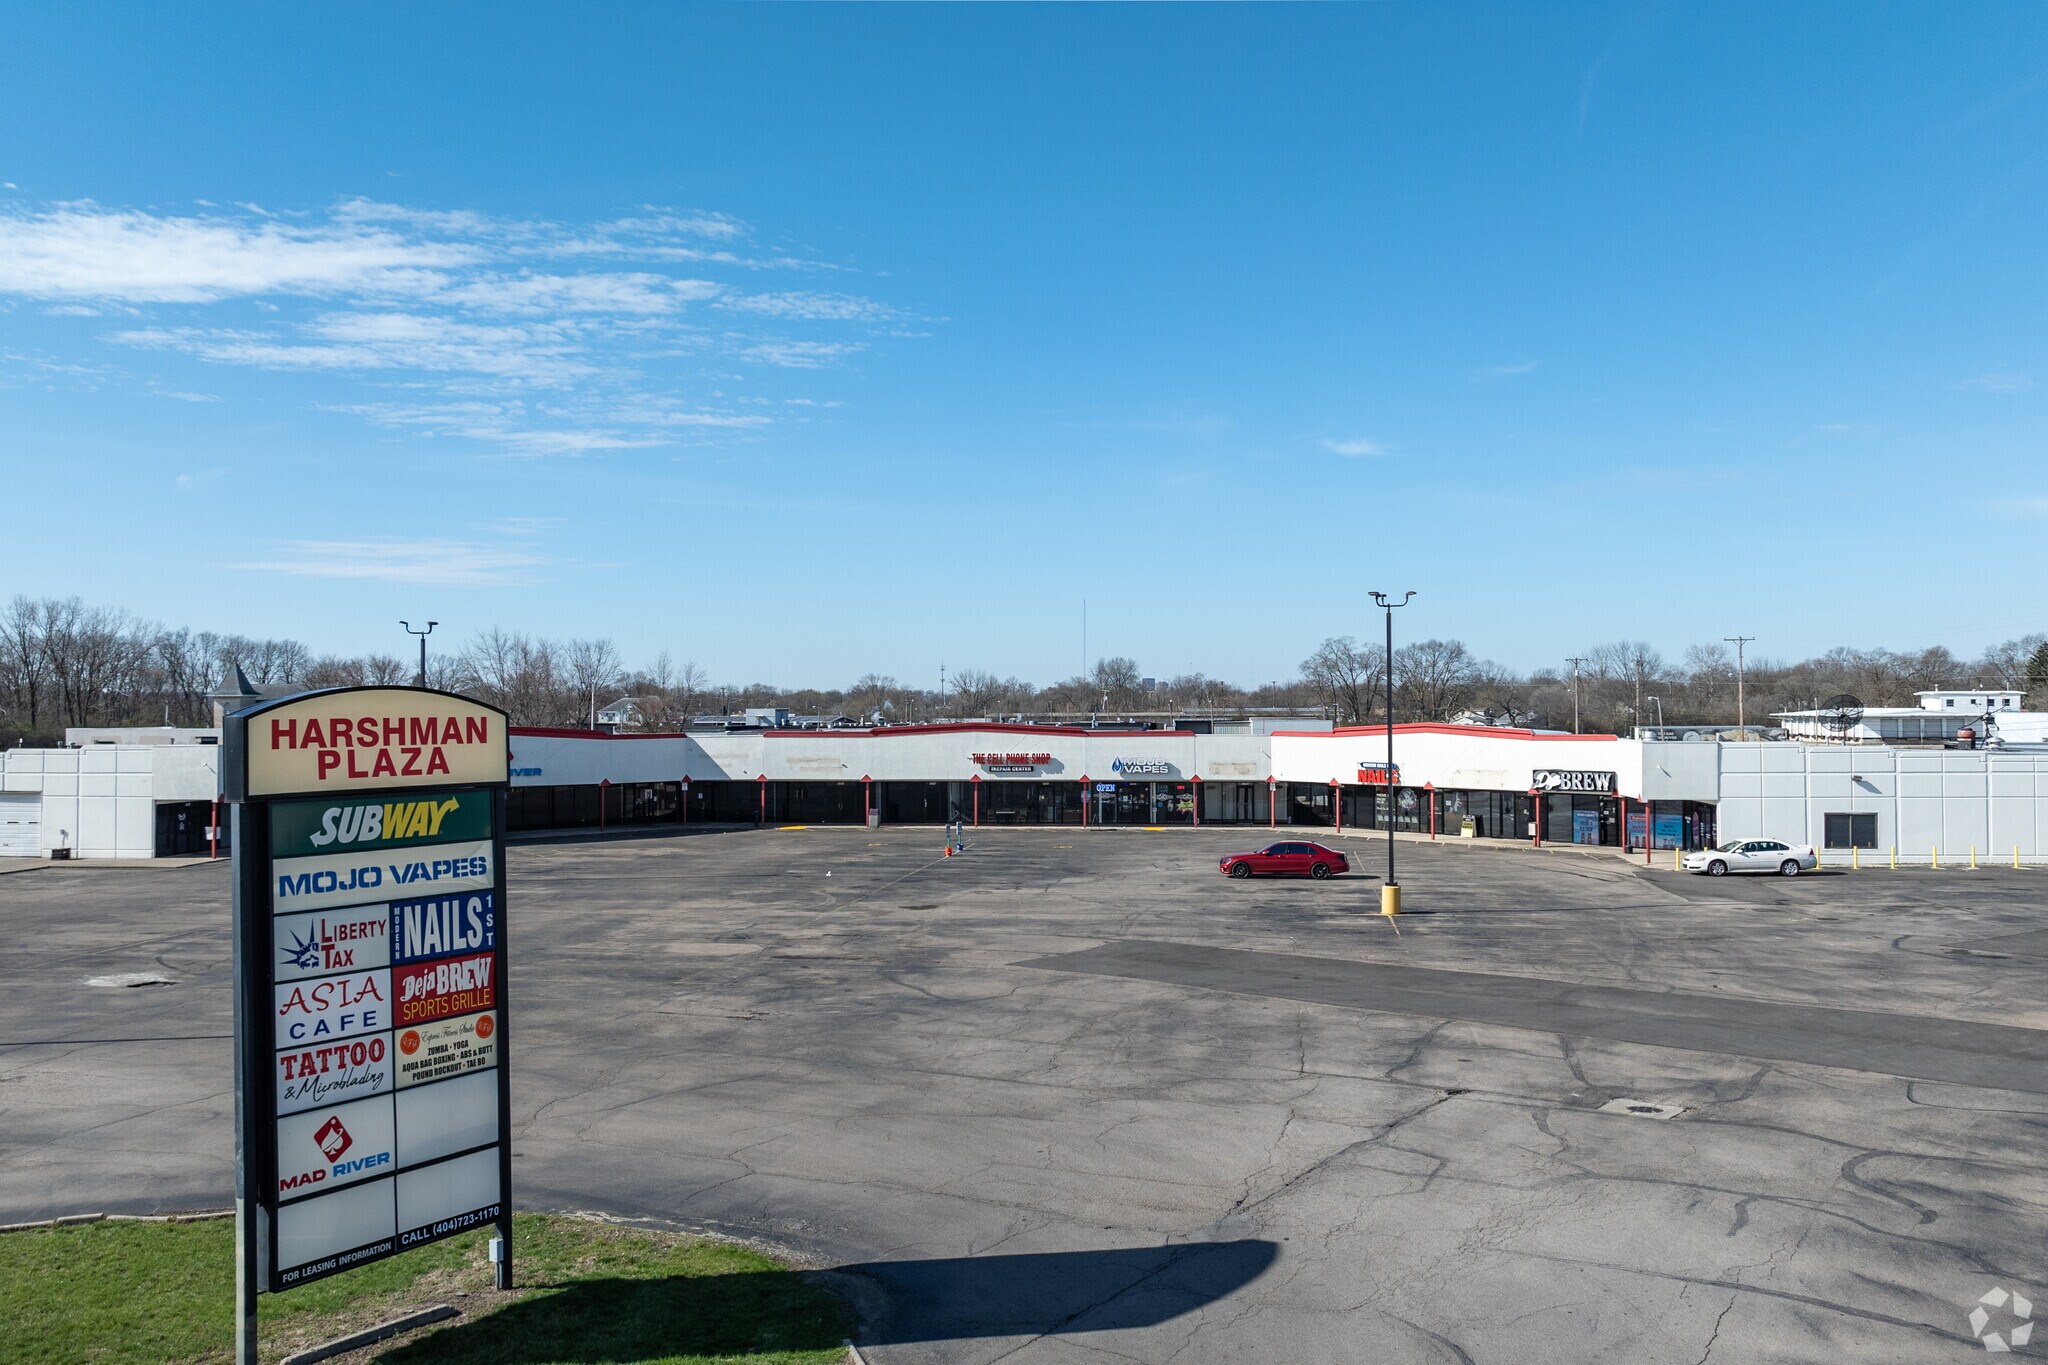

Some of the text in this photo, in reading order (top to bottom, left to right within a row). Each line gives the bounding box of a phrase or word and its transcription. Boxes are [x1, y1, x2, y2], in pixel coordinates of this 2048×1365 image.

[271, 716, 488, 750] HARSHMAN
[318, 747, 451, 780] PLAZA
[510, 768, 542, 776] IVER
[972, 753, 1051, 764] THE CELL PHONE SHOP
[1123, 756, 1166, 766] MOJO
[1123, 765, 1169, 774] VAPES
[1096, 784, 1115, 792] OPEN
[1559, 772, 1612, 791] BREW
[310, 796, 460, 848] SUBWAY
[279, 857, 487, 897] MOJO VAPES
[321, 918, 387, 944] LIBERTY
[403, 896, 483, 958] NAILS
[321, 943, 354, 969] TAX
[436, 957, 492, 995] BREW
[279, 975, 384, 1015] ASIA
[403, 988, 490, 1021] SPORTS GRILLE
[290, 1010, 377, 1040] CAFE
[281, 1038, 385, 1081] TATTOO
[402, 1061, 419, 1072] AQUA
[419, 1058, 433, 1069] BAG
[433, 1053, 456, 1066] BOXING
[460, 1050, 472, 1060] ABS
[478, 1045, 493, 1055] BUTT
[428, 1040, 469, 1056] ZUMBA YOGA
[284, 1064, 384, 1102] & Microblading
[412, 1057, 486, 1081] POUND ROCKOUT TAE BO
[280, 1151, 390, 1192] MAD RIVER
[401, 1206, 500, 1245] CALL (404)723-1170
[282, 1241, 392, 1283] FOR LEASING INFORMATION
